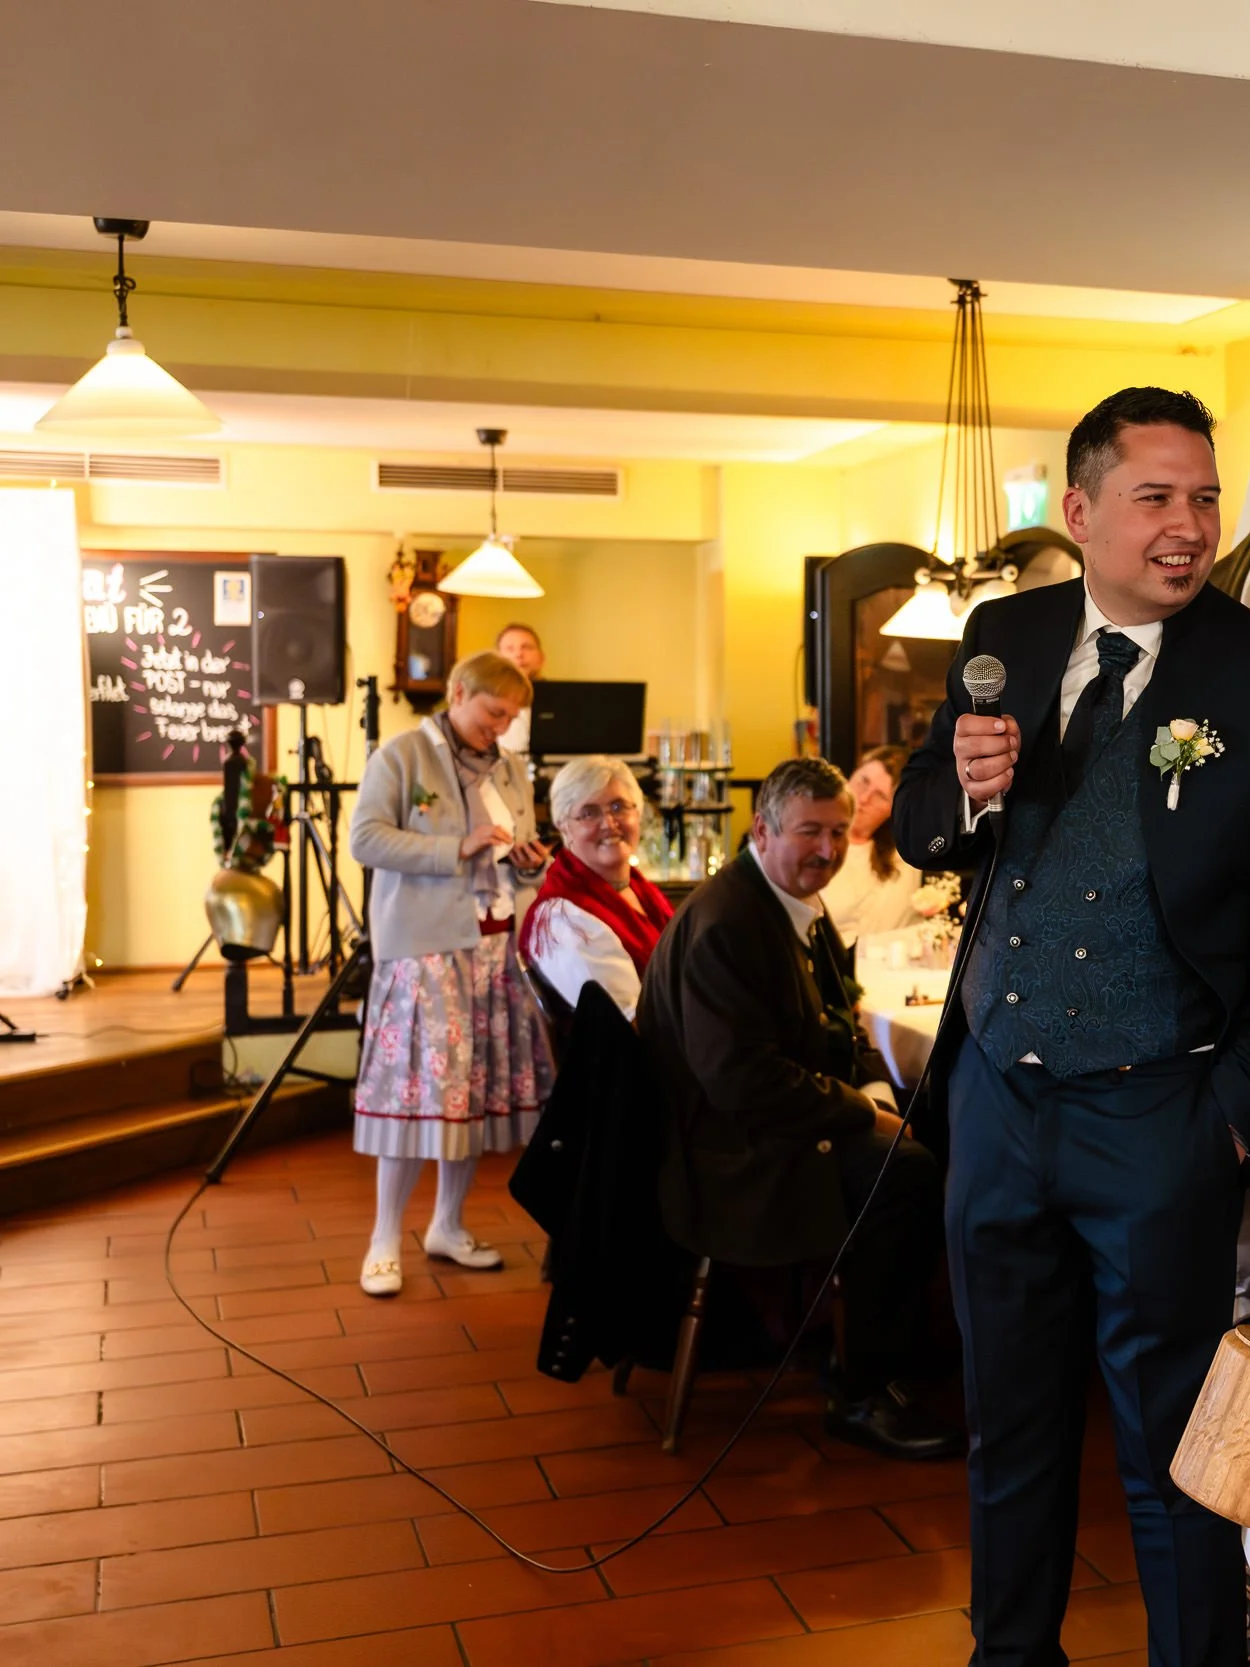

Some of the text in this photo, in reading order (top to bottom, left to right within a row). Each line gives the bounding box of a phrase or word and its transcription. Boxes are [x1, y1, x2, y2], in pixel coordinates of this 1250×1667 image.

[124, 602, 164, 634] FÜR
[168, 608, 192, 636] 2
[184, 650, 198, 672] in
[201, 649, 231, 674] der
[142, 669, 186, 694] POST
[202, 681, 231, 698] nur
